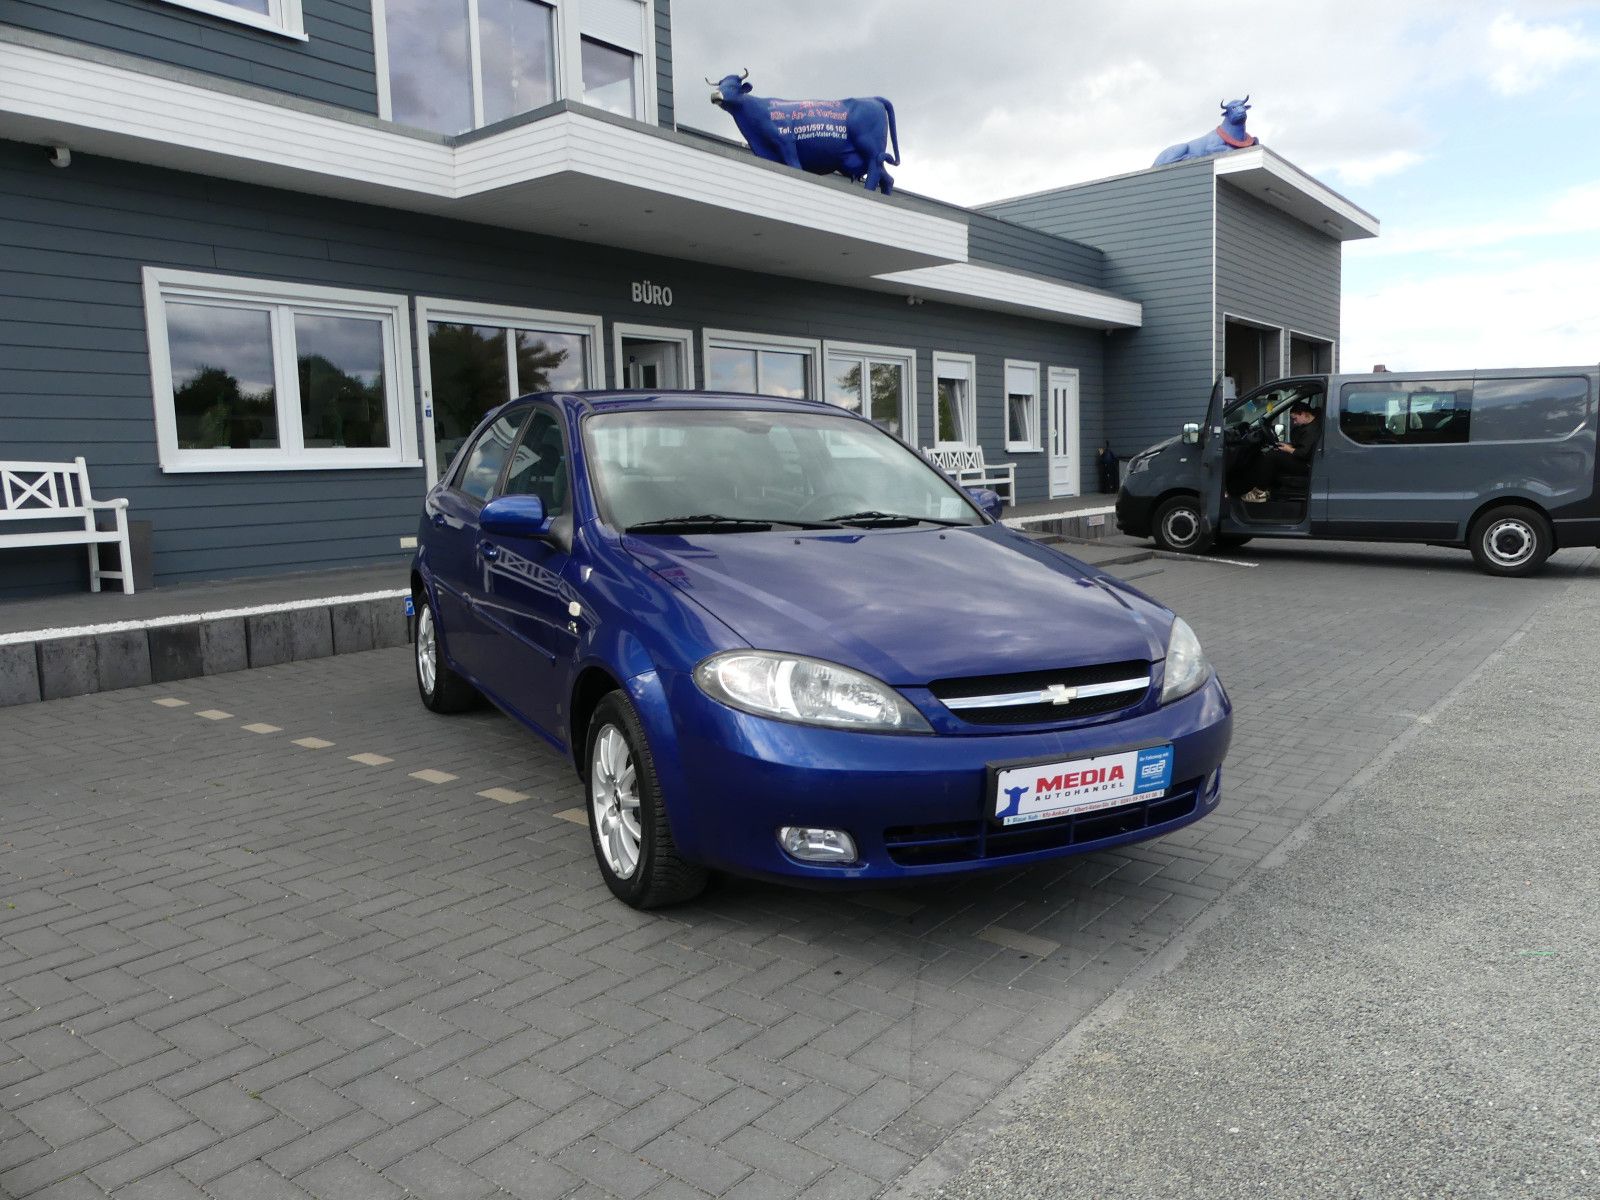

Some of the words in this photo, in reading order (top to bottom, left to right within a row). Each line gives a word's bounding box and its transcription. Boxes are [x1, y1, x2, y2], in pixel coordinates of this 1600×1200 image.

[778, 126, 792, 135] Tel.
[835, 125, 847, 133] 100
[632, 280, 673, 307] BÜRO
[1035, 764, 1125, 794] MEDIA
[1035, 782, 1125, 802] AUTOHANDEL
